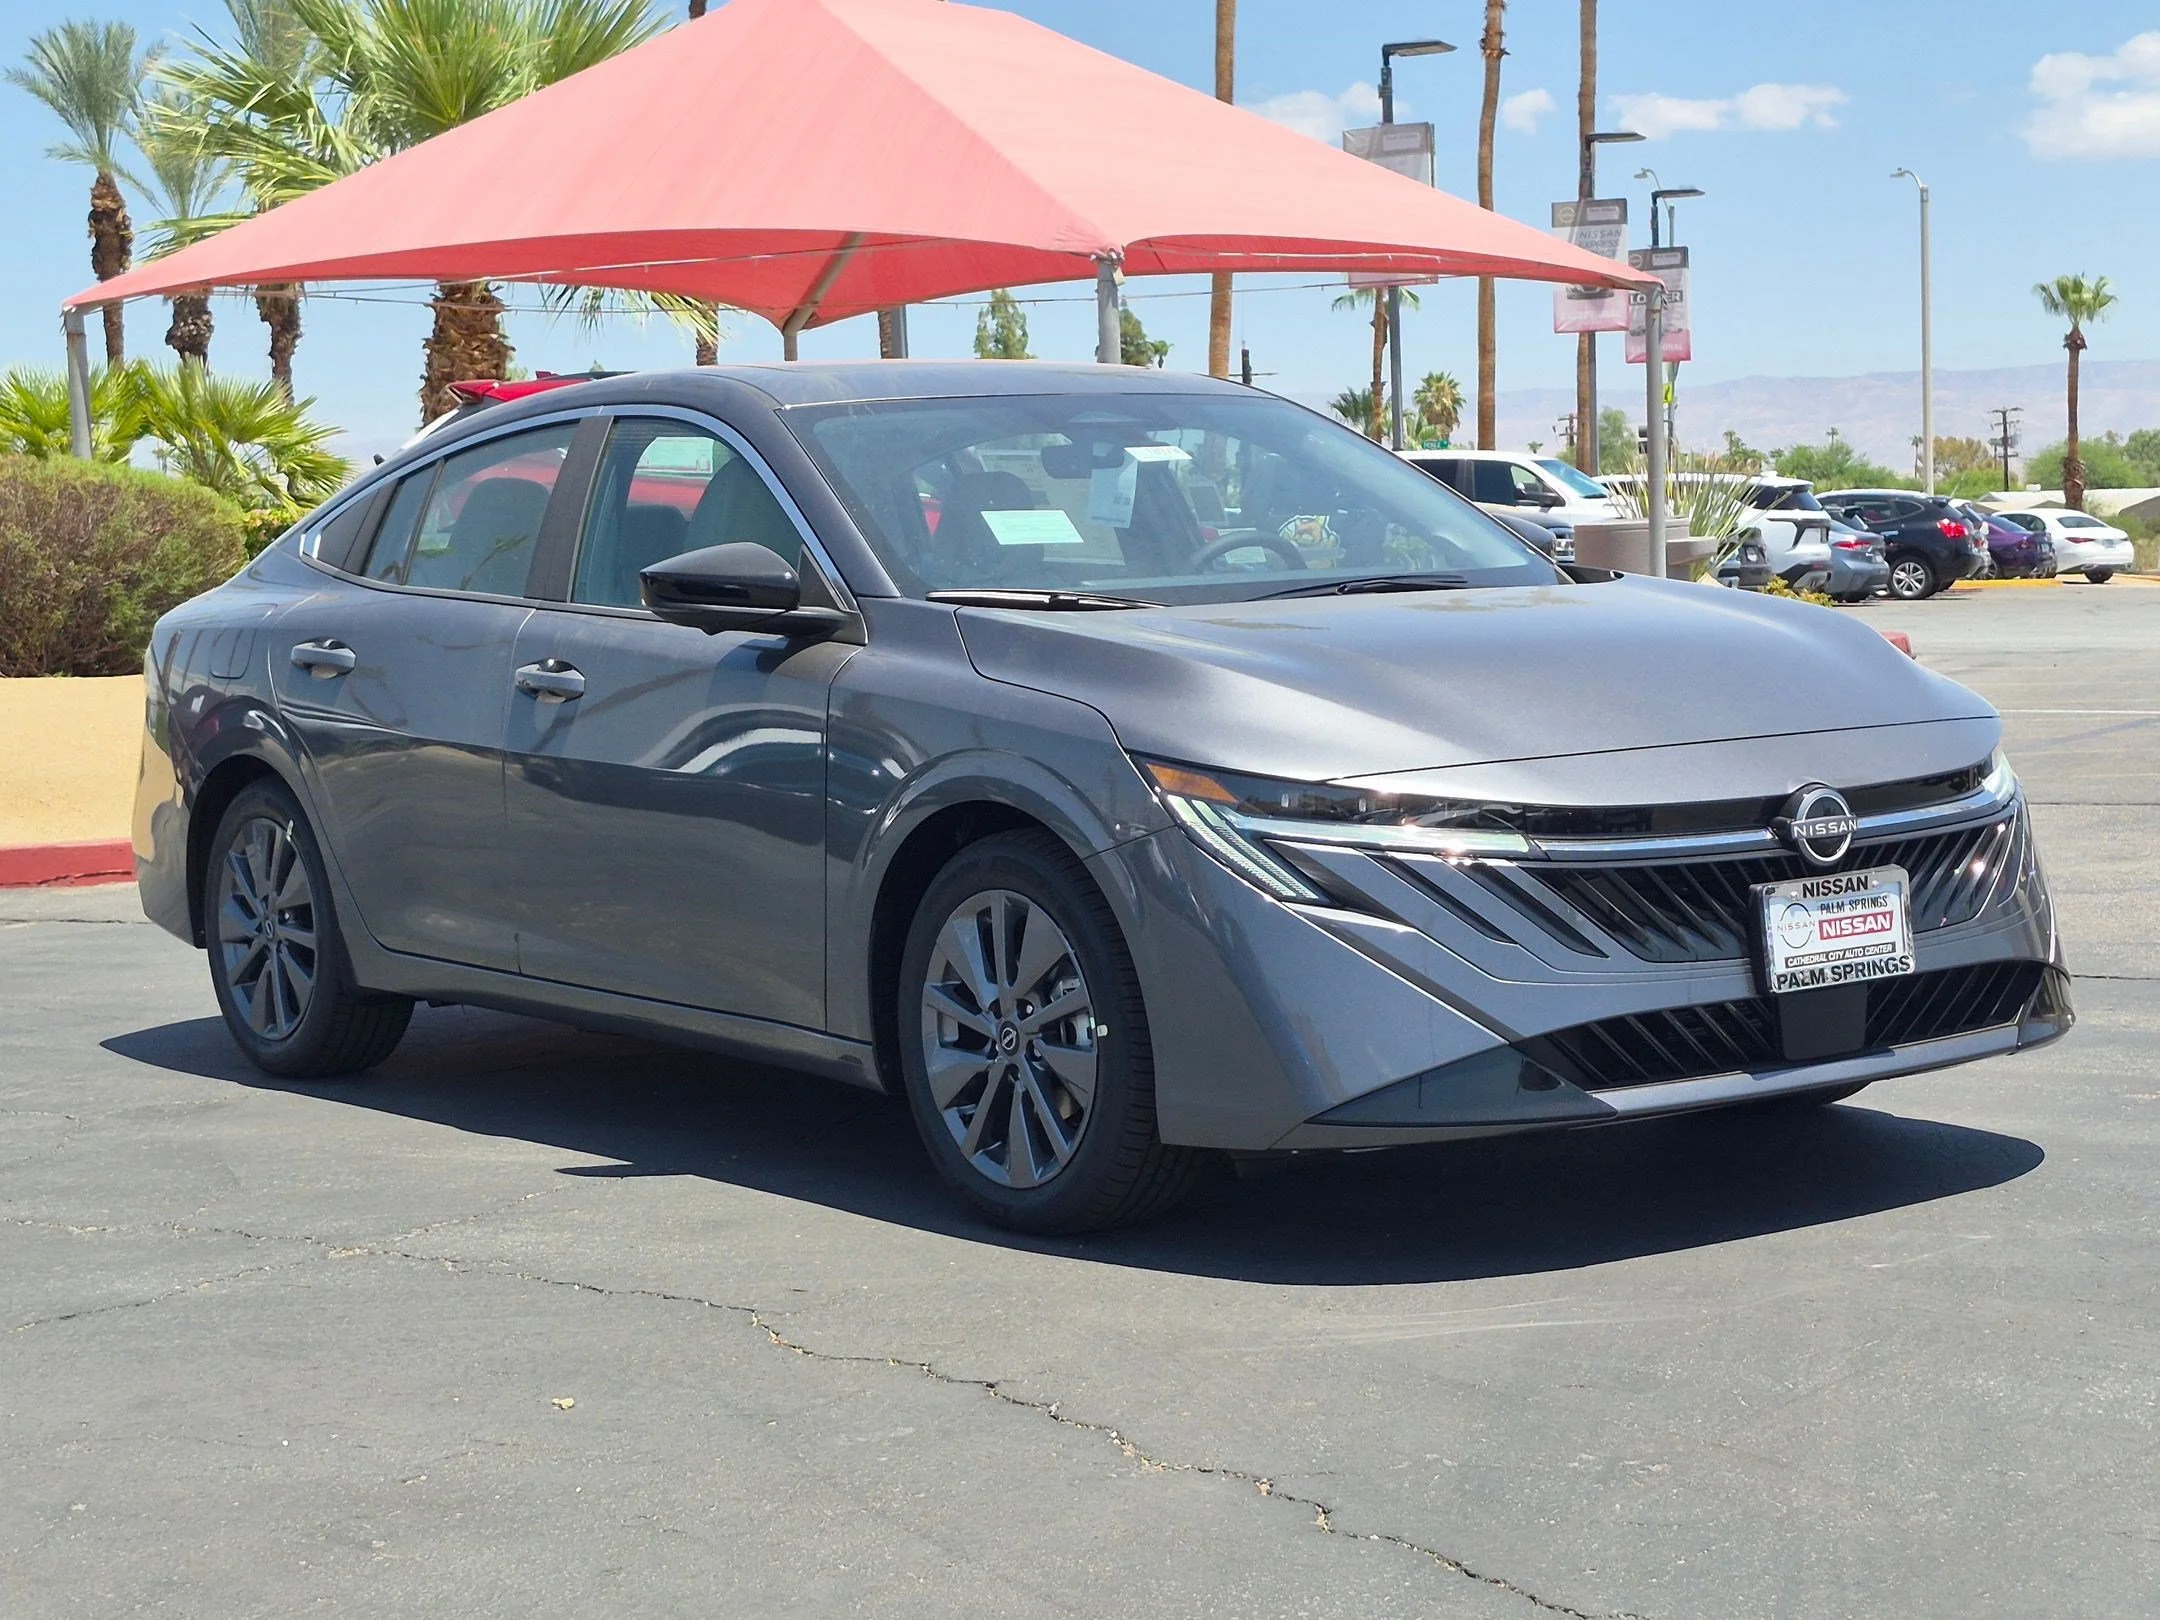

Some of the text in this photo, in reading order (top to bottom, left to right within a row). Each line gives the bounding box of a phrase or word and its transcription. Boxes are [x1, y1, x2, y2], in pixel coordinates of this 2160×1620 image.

[1579, 229, 1622, 240] NISSAN
[1793, 818, 1857, 838] NISSAN
[1802, 875, 1869, 899] NISSAN
[1820, 895, 1889, 915] PALM SPRINGS
[1776, 920, 1816, 932] NISSAN
[1822, 913, 1890, 938] NISSAN
[1787, 944, 1893, 967] CATHEDRAL CITY AUTO CENTER
[1776, 955, 1911, 991] PALM SPRINGS
